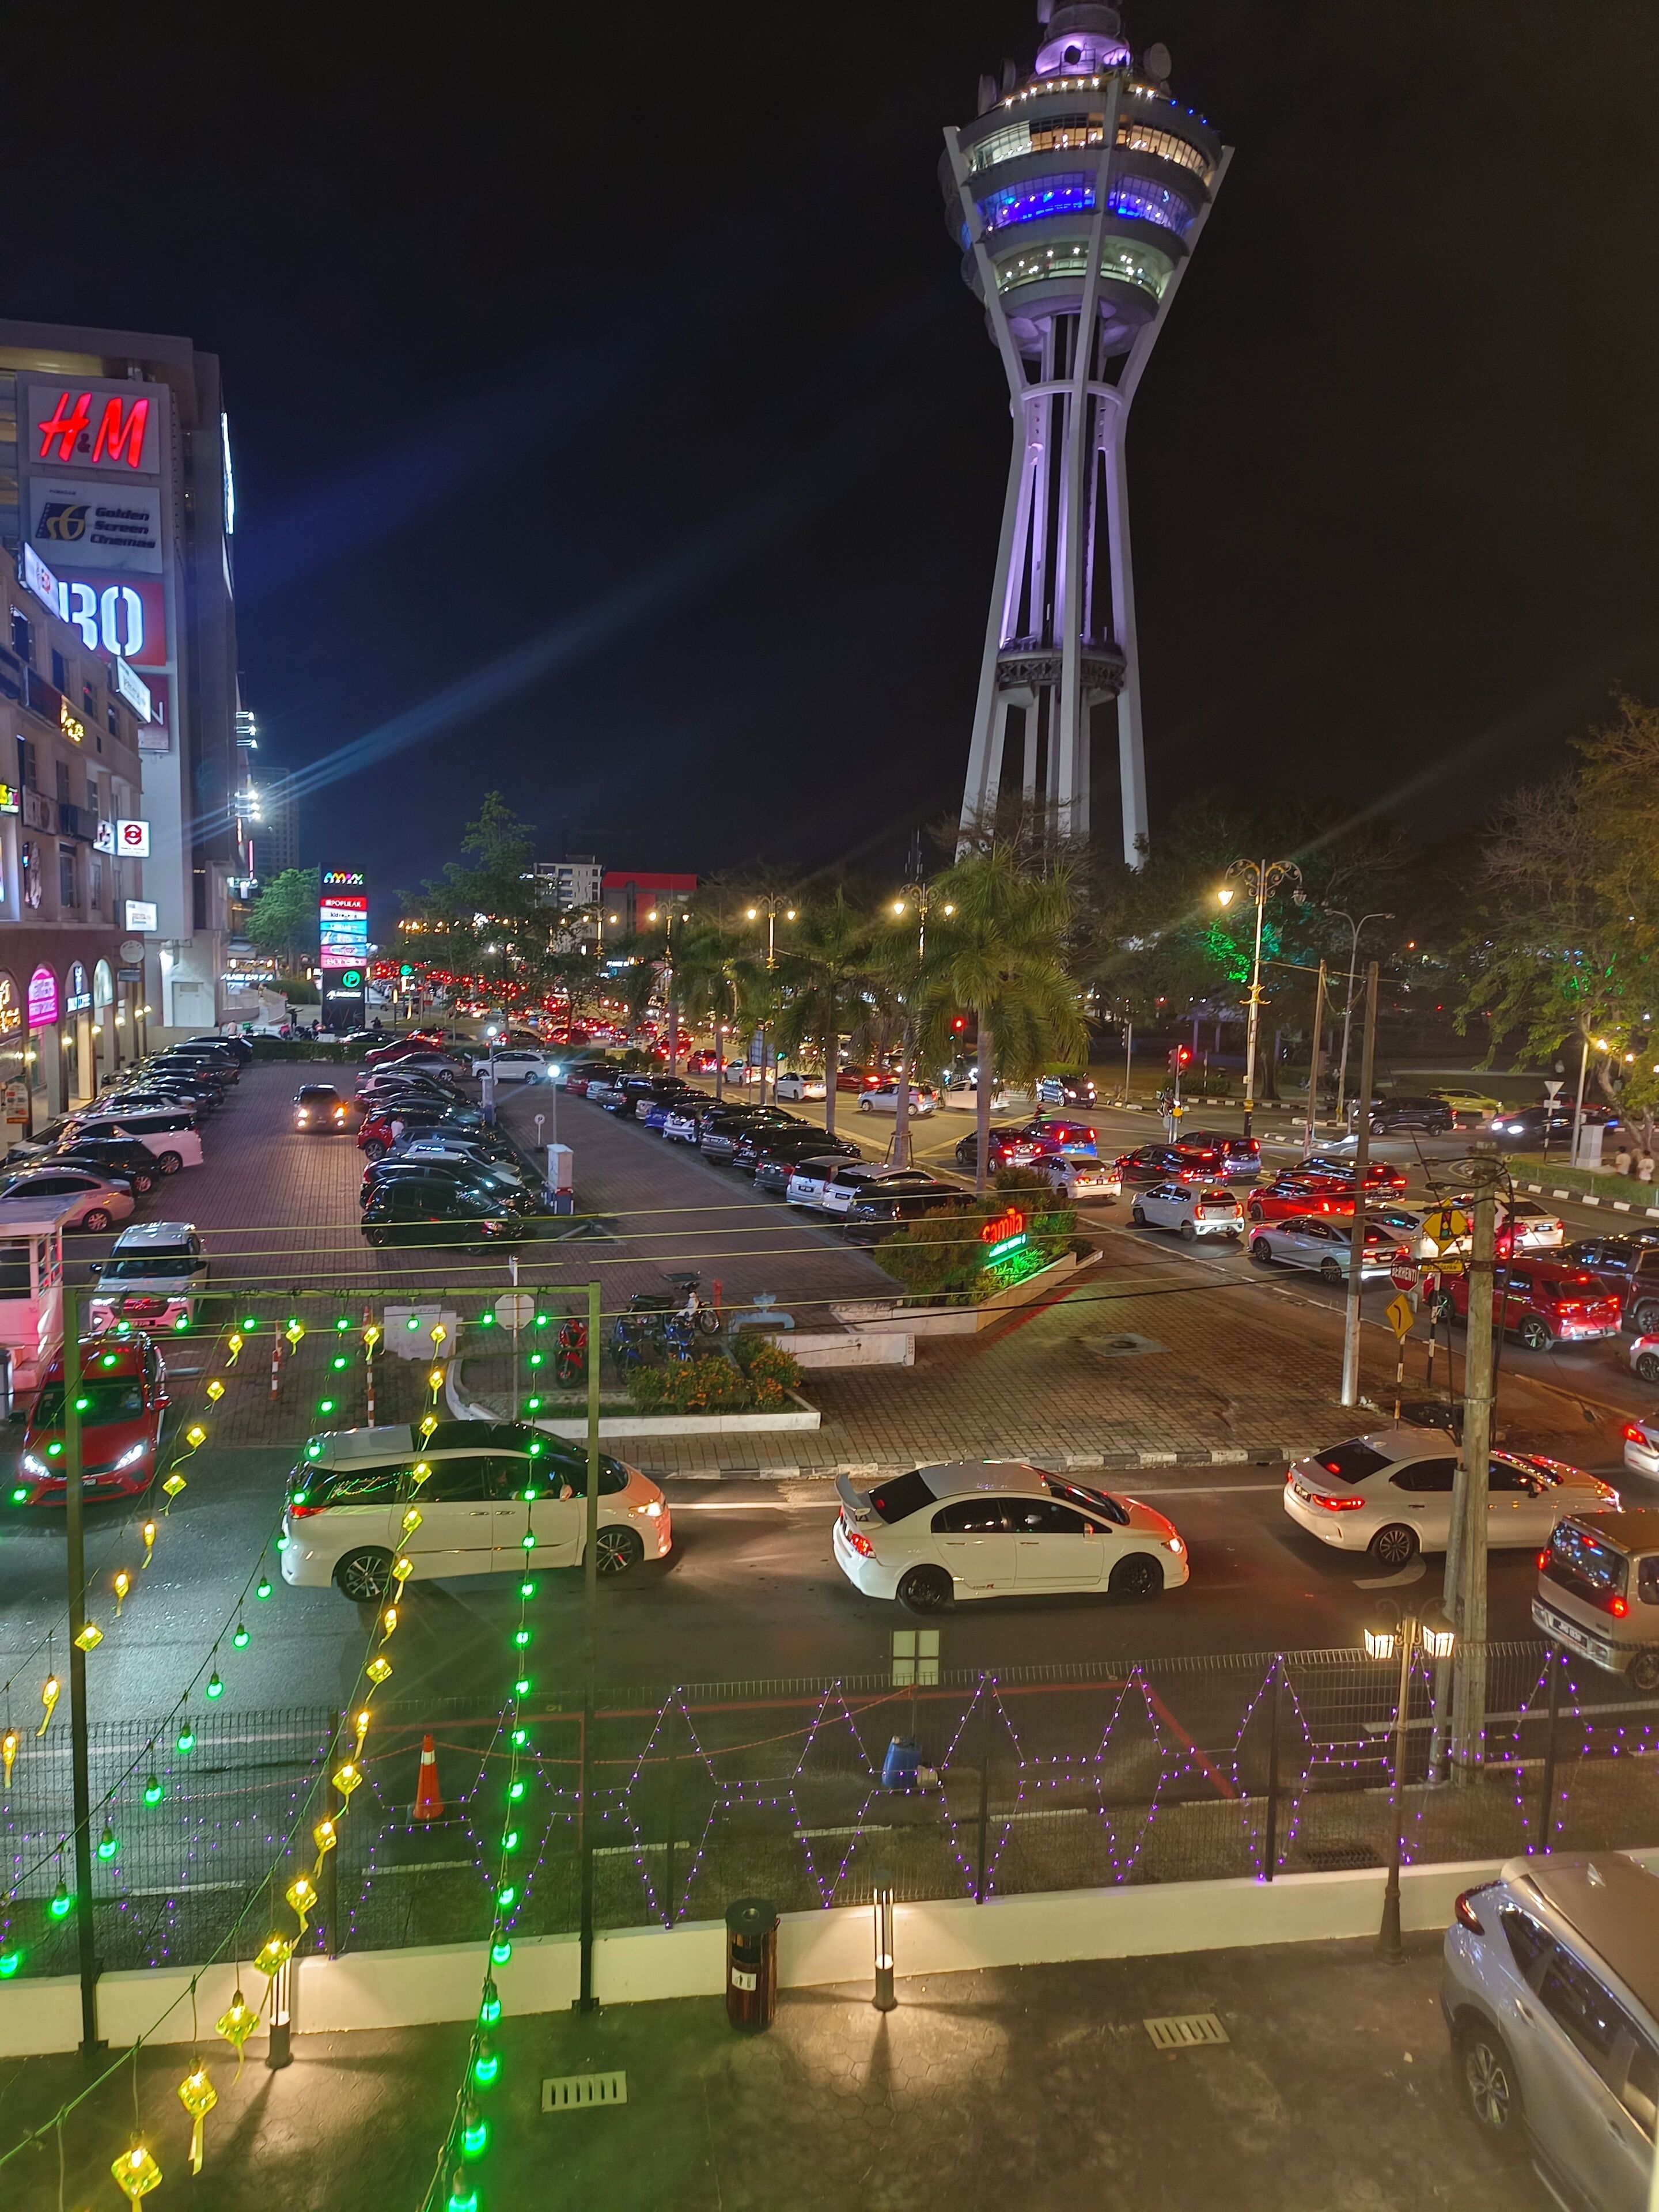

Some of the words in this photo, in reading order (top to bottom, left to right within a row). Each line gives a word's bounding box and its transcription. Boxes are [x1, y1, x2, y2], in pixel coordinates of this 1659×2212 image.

[38, 392, 149, 469] H&M
[94, 507, 150, 521] Golden
[93, 520, 149, 535] Screen
[90, 534, 156, 549] Cinemas
[331, 900, 362, 908] POPULAR
[1392, 1264, 1417, 1283] BERHENTI
